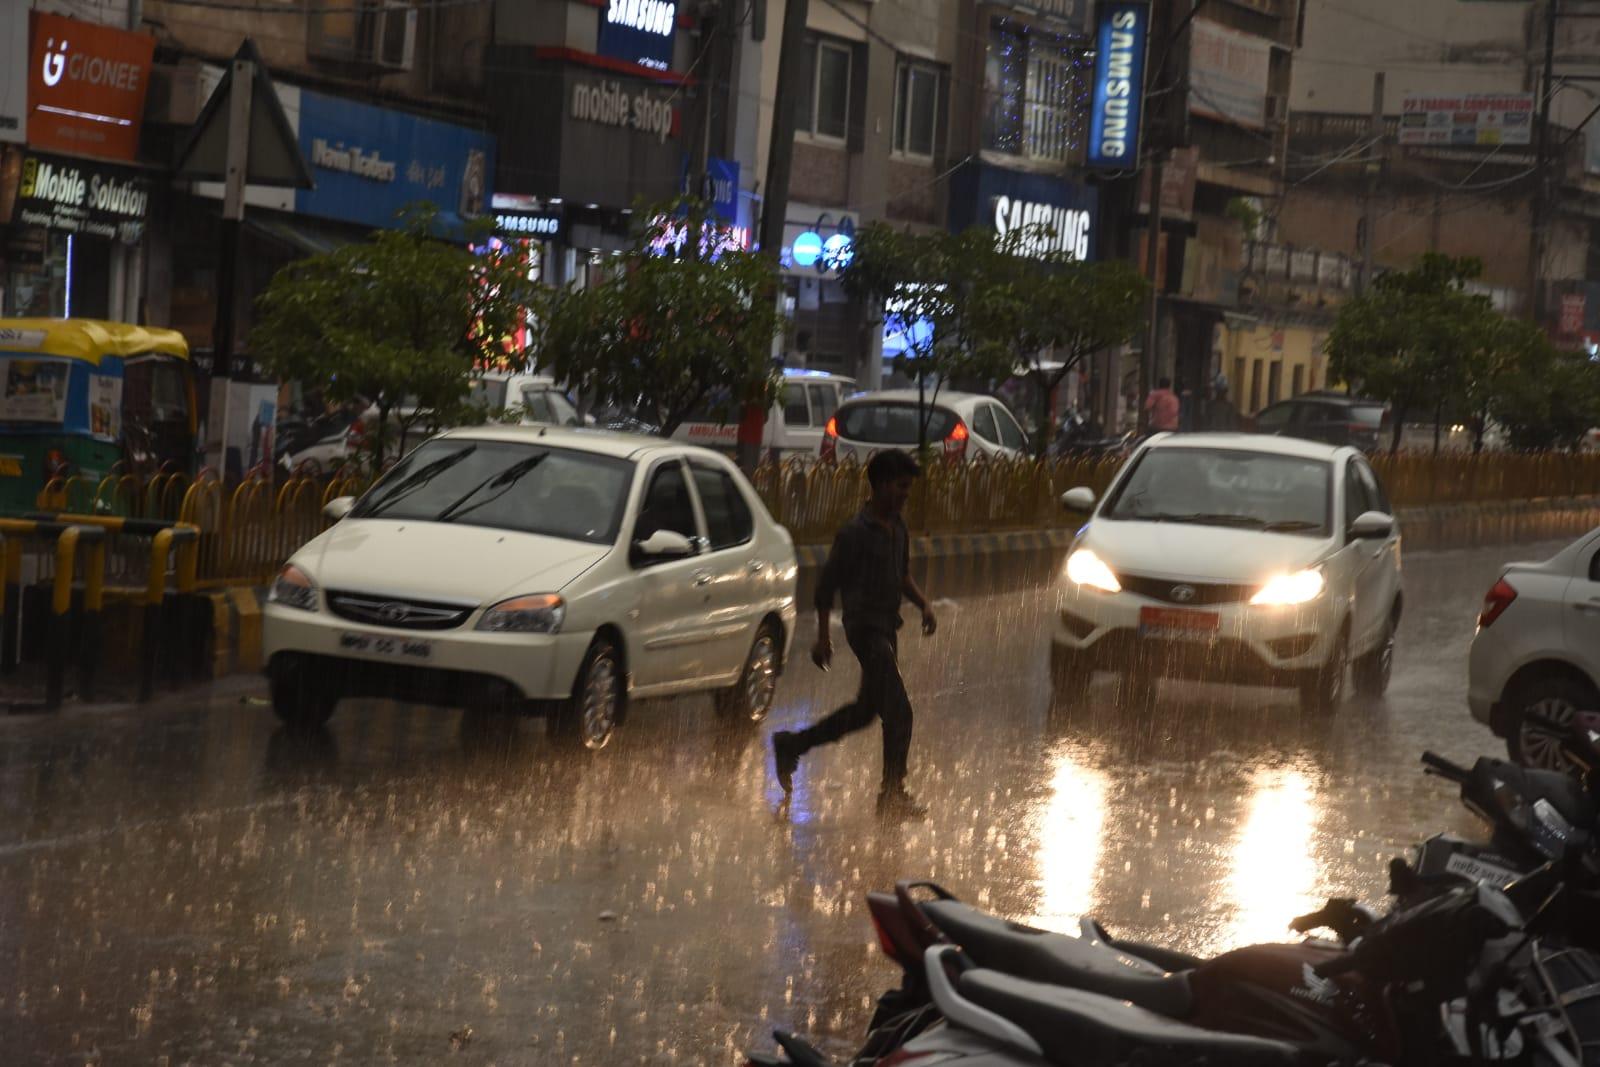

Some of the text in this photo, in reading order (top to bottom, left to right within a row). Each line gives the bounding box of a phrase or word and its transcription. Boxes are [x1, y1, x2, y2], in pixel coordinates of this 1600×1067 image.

[607, 0, 676, 37] SAMSUNG
[68, 53, 141, 91] GIONEE
[1101, 10, 1137, 158] SAMSUNG
[573, 79, 673, 144] mobile shop
[33, 162, 87, 206] Mobile
[87, 173, 149, 217] Solution
[688, 424, 738, 440] AMBULANC
